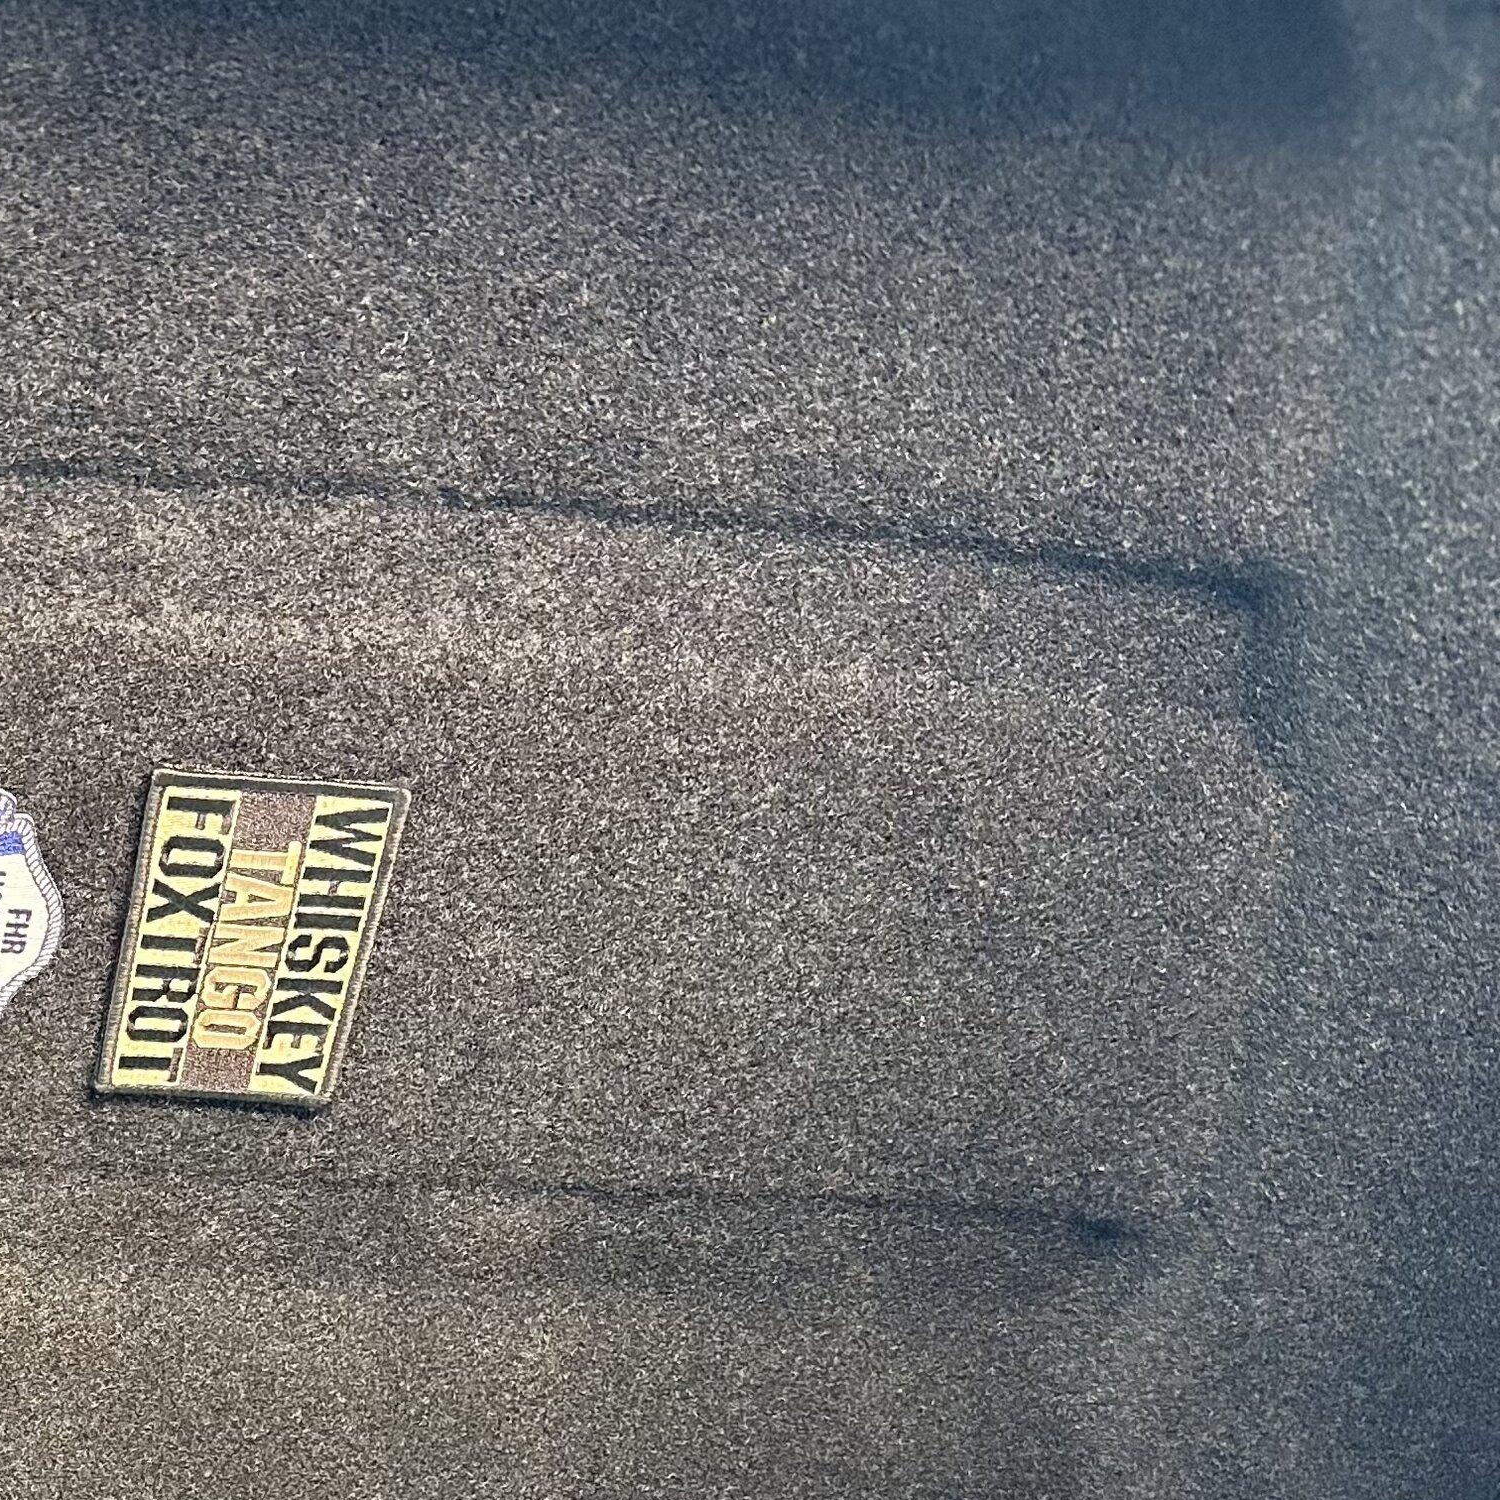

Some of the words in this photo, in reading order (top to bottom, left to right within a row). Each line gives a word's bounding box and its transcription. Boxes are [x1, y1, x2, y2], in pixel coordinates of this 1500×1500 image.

[0, 908, 32, 954] FHR
[118, 795, 234, 1083] FOXTROT
[191, 841, 302, 1051] TANGO
[255, 806, 389, 1094] WHISKEY
